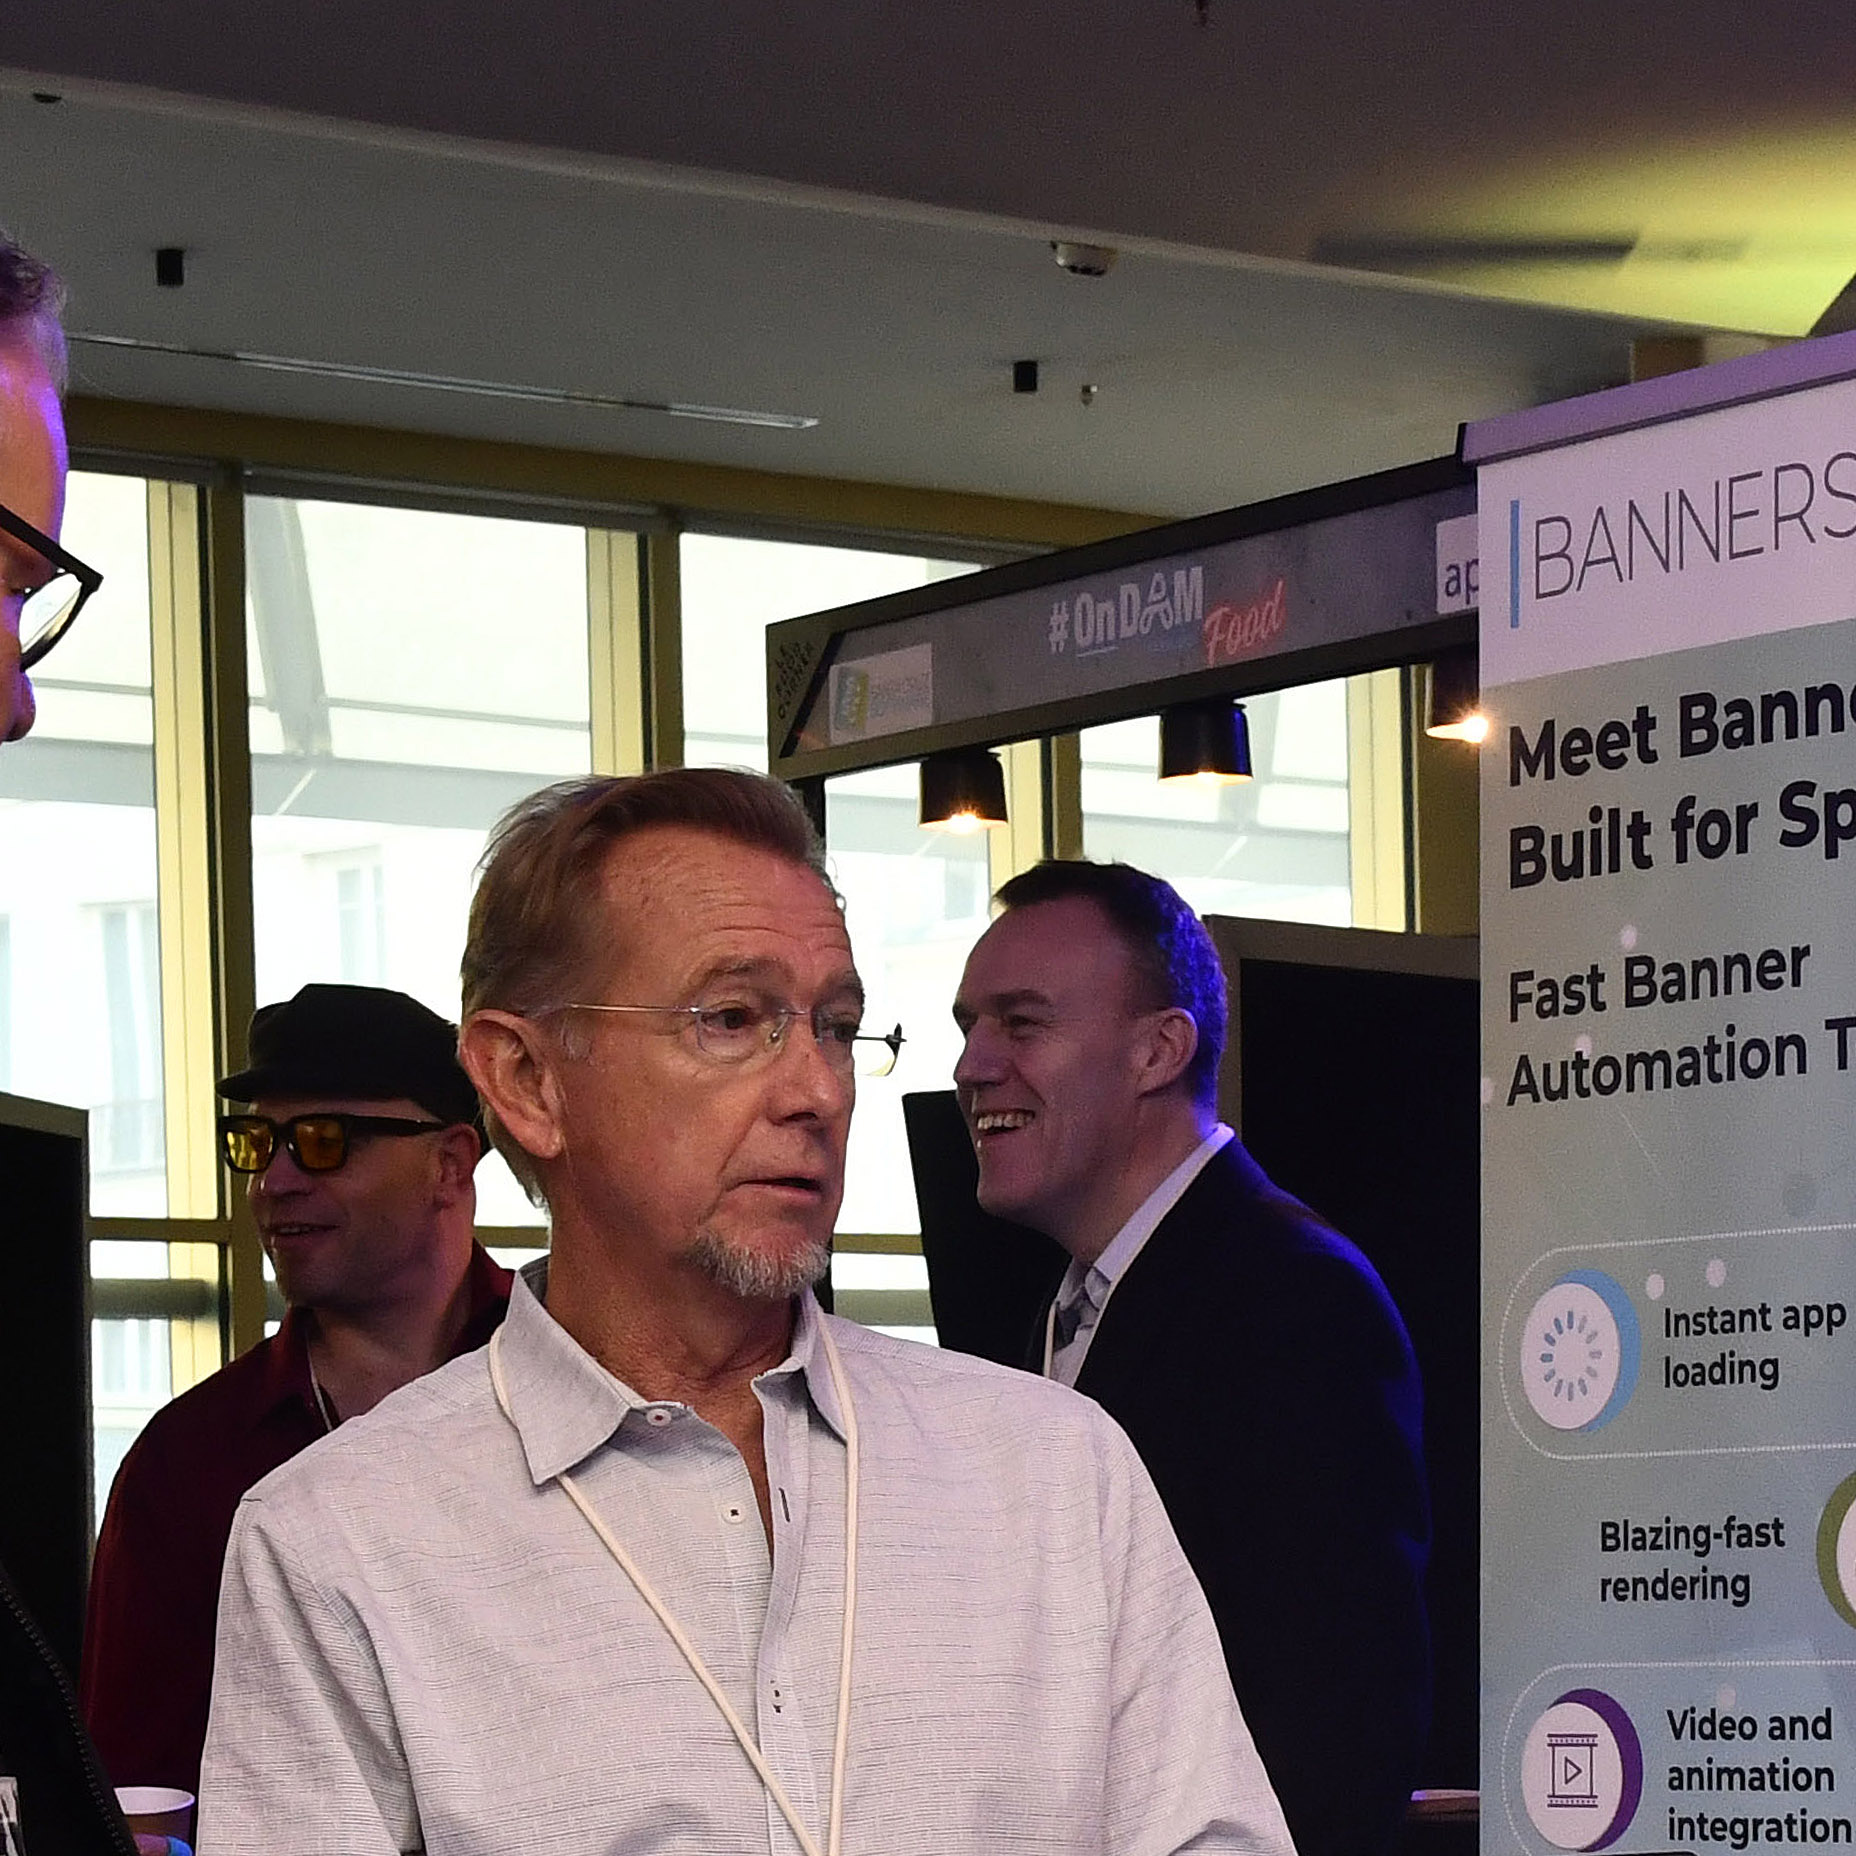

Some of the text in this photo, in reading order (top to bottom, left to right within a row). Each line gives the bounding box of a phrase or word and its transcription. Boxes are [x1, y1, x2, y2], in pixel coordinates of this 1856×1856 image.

[1444, 558, 1479, 609] ap
[1203, 579, 1285, 669] Food
[1508, 704, 1660, 788] Meet
[1508, 804, 1654, 889] Built
[1671, 795, 1760, 865] for
[1508, 943, 1812, 1023] Fast Banner
[1505, 1022, 1809, 1107] Automation
[1662, 1296, 1848, 1341] Instant app
[1662, 1349, 1781, 1391] loading
[1599, 1513, 1787, 1562] Blazing-fast
[1599, 1564, 1753, 1608] rendering
[1666, 1706, 1833, 1744] Video and
[1666, 1758, 1836, 1794] animation
[1666, 1807, 1853, 1850] integration
